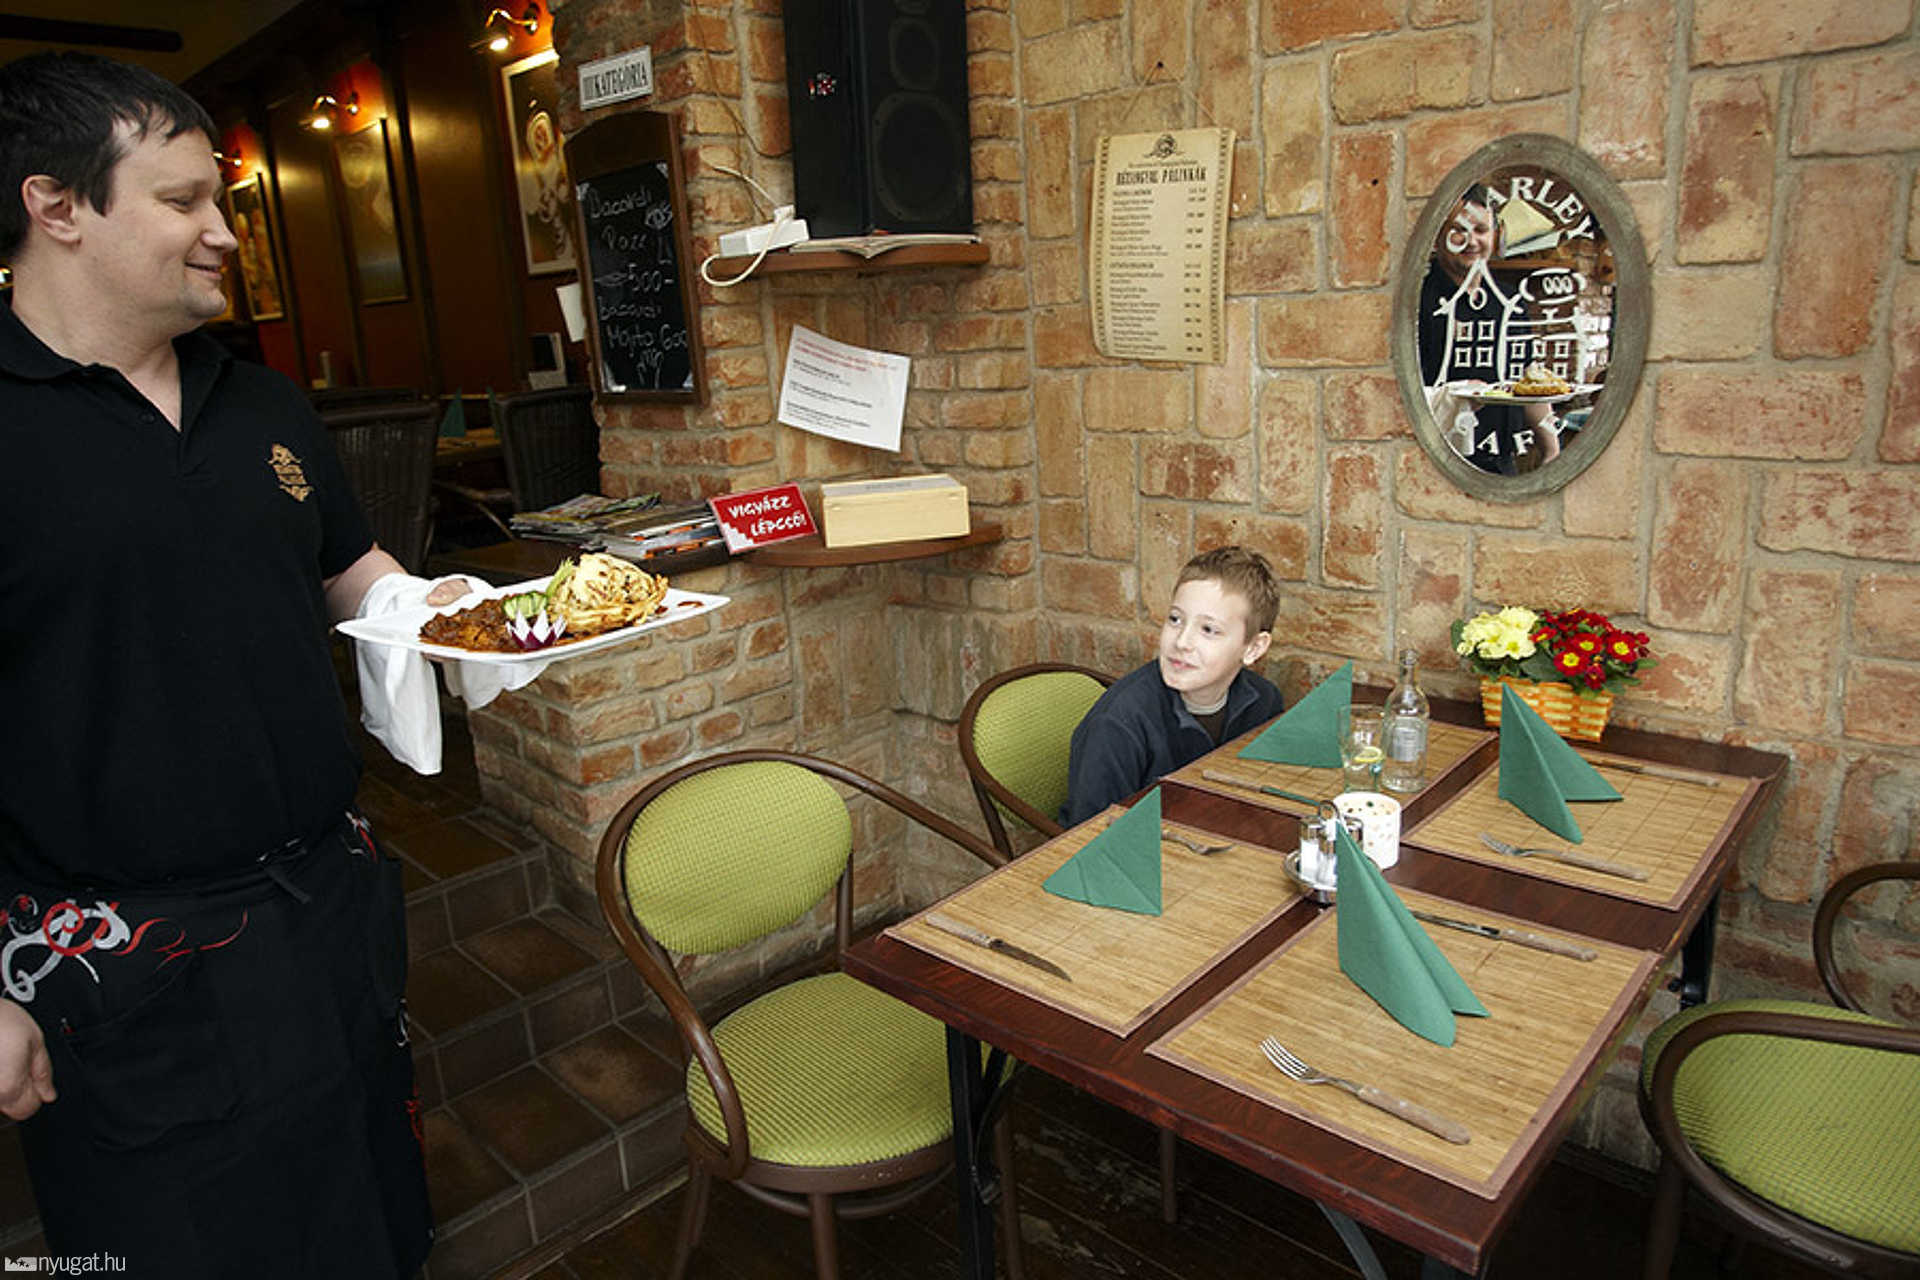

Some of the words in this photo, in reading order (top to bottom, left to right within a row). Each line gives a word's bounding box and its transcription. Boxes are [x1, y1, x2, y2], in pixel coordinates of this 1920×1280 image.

[1445, 176, 1595, 254] CHARLEY
[727, 493, 793, 519] VIGYÁZZ
[750, 513, 808, 537] LÉPCSŐ!
